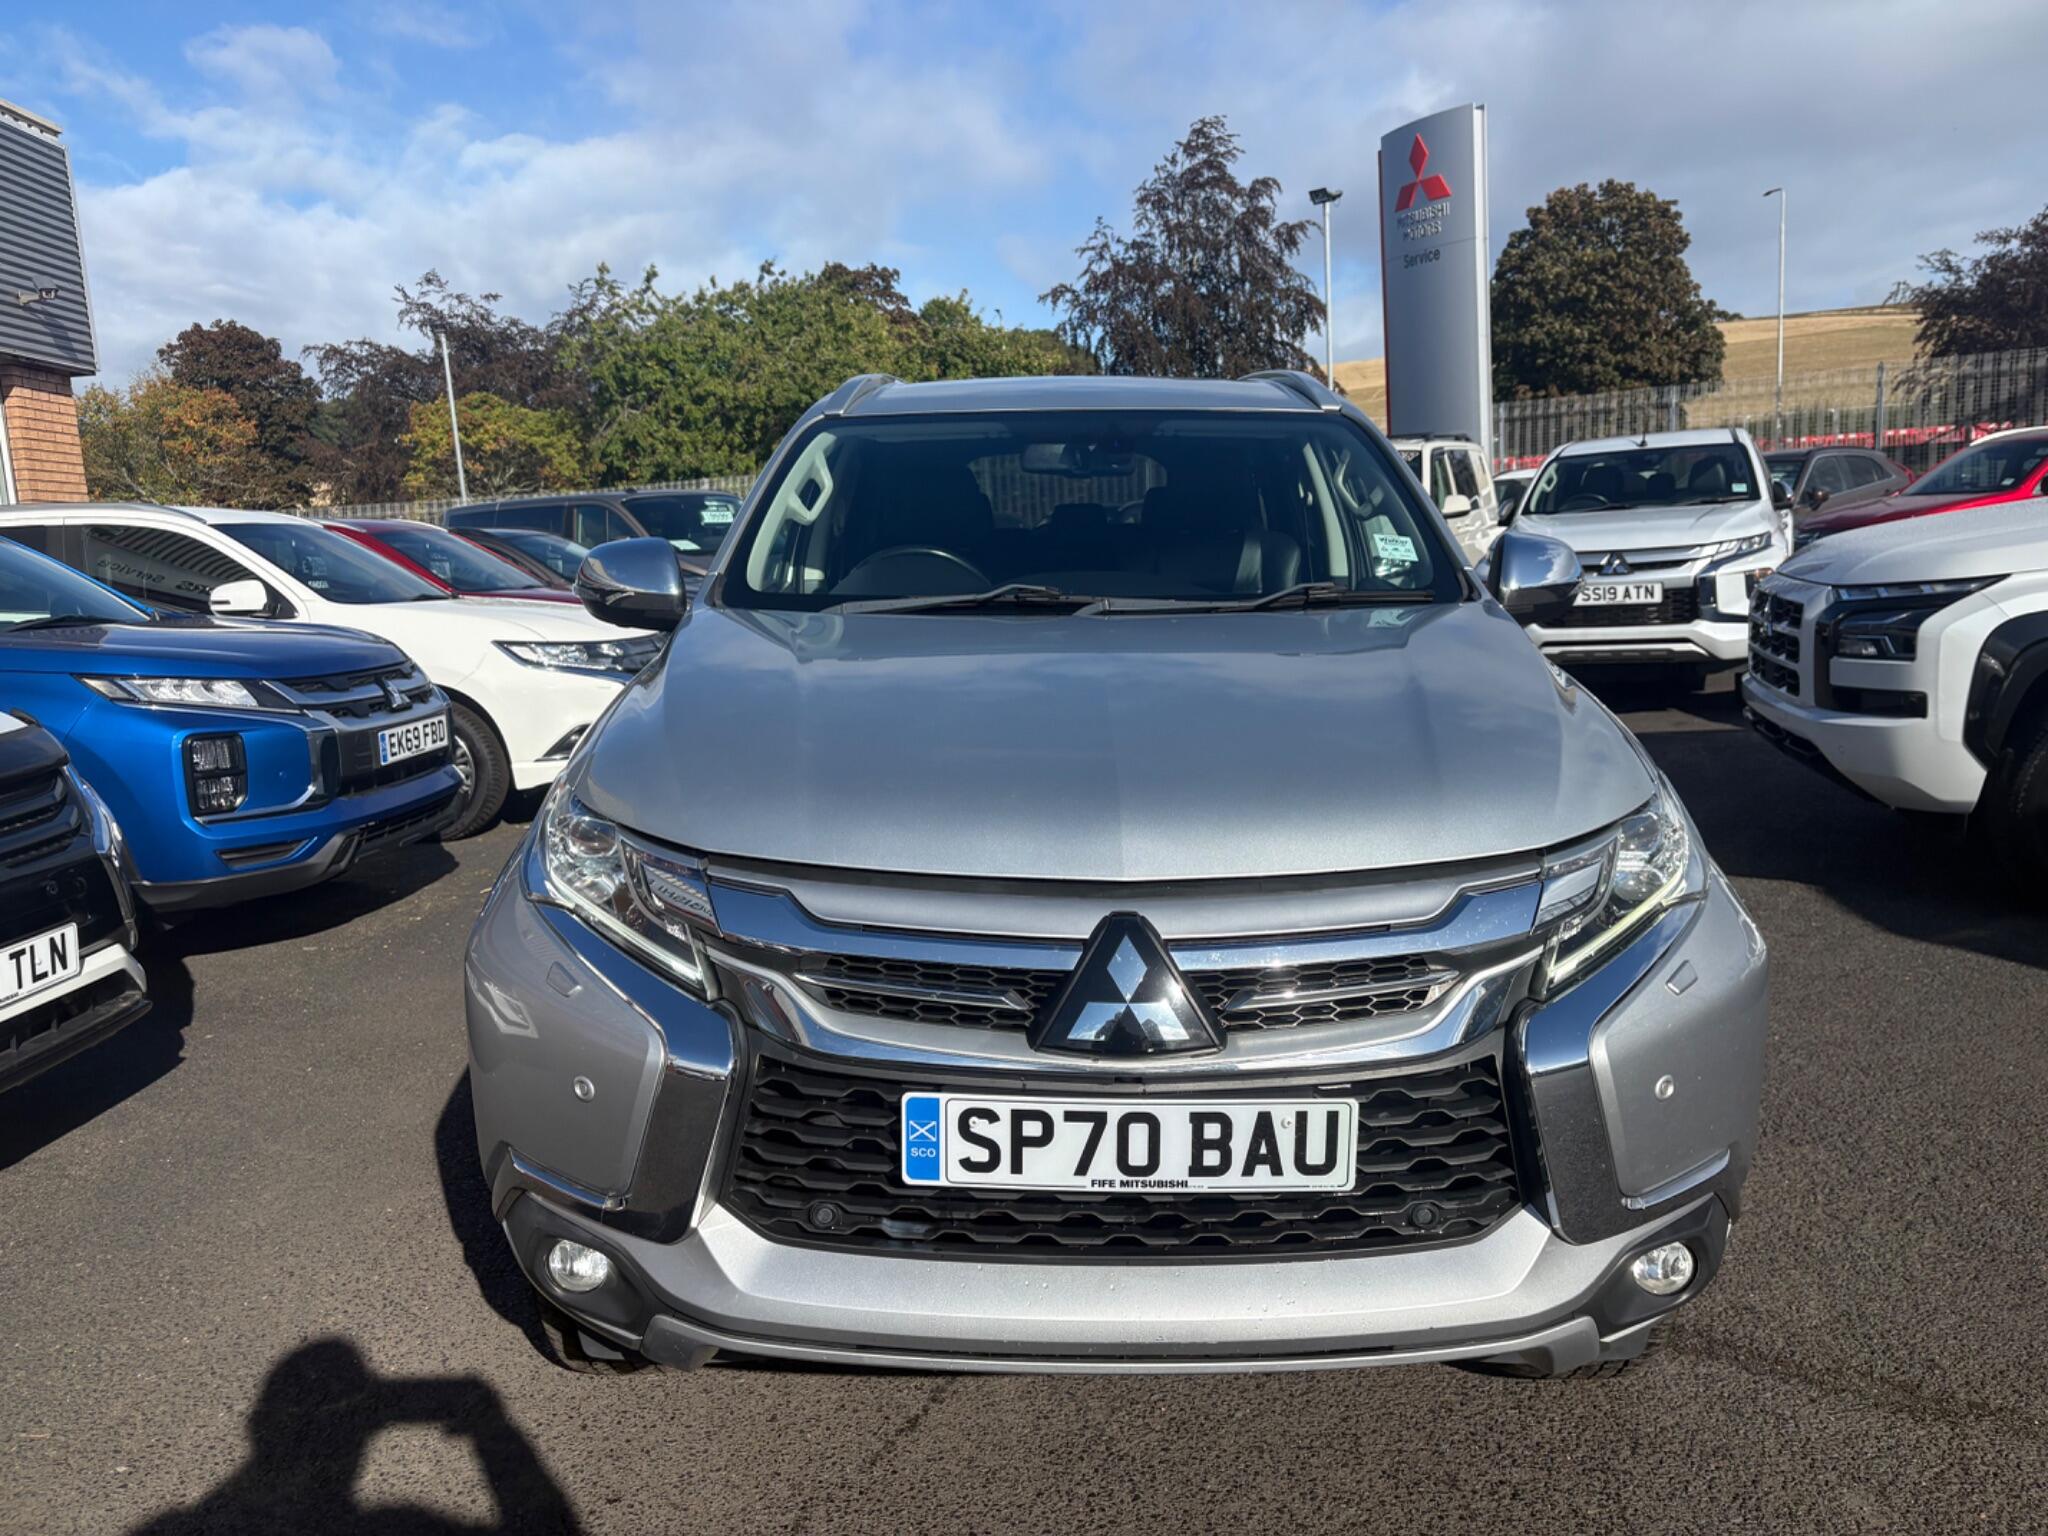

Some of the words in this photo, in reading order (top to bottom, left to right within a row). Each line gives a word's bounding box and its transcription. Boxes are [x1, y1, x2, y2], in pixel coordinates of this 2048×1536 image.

[1403, 249, 1441, 269] Service
[1582, 586, 1617, 601] SS19
[1623, 584, 1655, 600] ATN
[388, 726, 421, 757] EK69
[423, 719, 446, 747] FBD
[9, 932, 68, 990] TLN
[910, 1147, 937, 1158] SCO
[957, 1107, 1161, 1178] SP70
[1188, 1110, 1340, 1178] BAU
[1091, 1179, 1117, 1188] FIFE
[1119, 1179, 1189, 1189] MITSUBISHI
